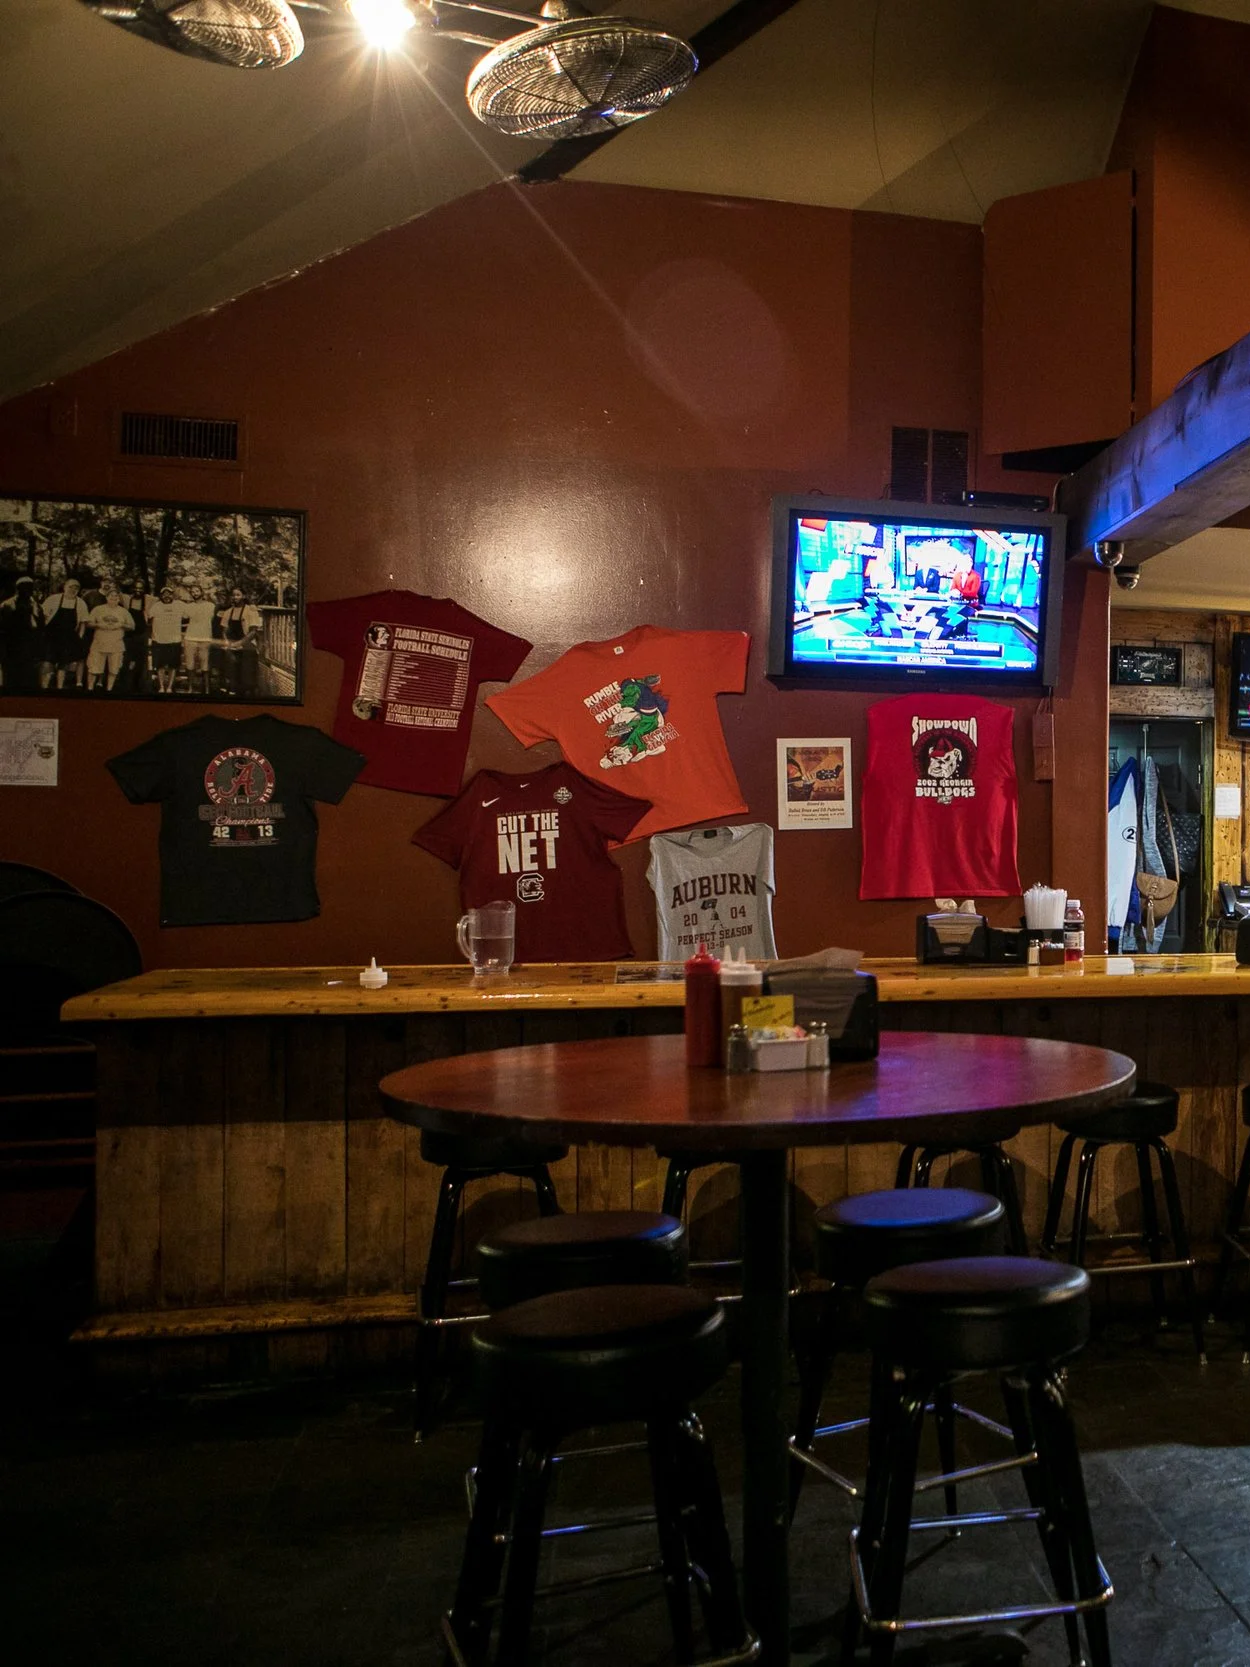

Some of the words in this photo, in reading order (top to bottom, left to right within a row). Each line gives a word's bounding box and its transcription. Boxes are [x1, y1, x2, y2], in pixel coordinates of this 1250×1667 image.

[393, 639, 430, 654] FOOTBALL
[431, 645, 468, 660] SCHEDULE
[583, 680, 621, 708] RUMBLE
[595, 703, 622, 724] RIVER
[912, 716, 978, 747] SHOWDOWN
[214, 749, 265, 766] ALABAMA
[259, 782, 274, 802] TIDE
[915, 787, 976, 798] BULLDOGS
[940, 779, 974, 787] GEORGIA
[212, 826, 230, 838] 42
[216, 816, 270, 827] Champions
[258, 825, 274, 837] 13
[496, 815, 527, 834] CUT
[531, 812, 560, 832] THE
[1126, 828, 1135, 840] 2
[497, 830, 560, 874] NET
[671, 873, 757, 909] AUBURN
[683, 913, 698, 927] 20
[730, 905, 747, 920] 04
[677, 932, 716, 946] PERFECT
[719, 924, 754, 940] SEASON
